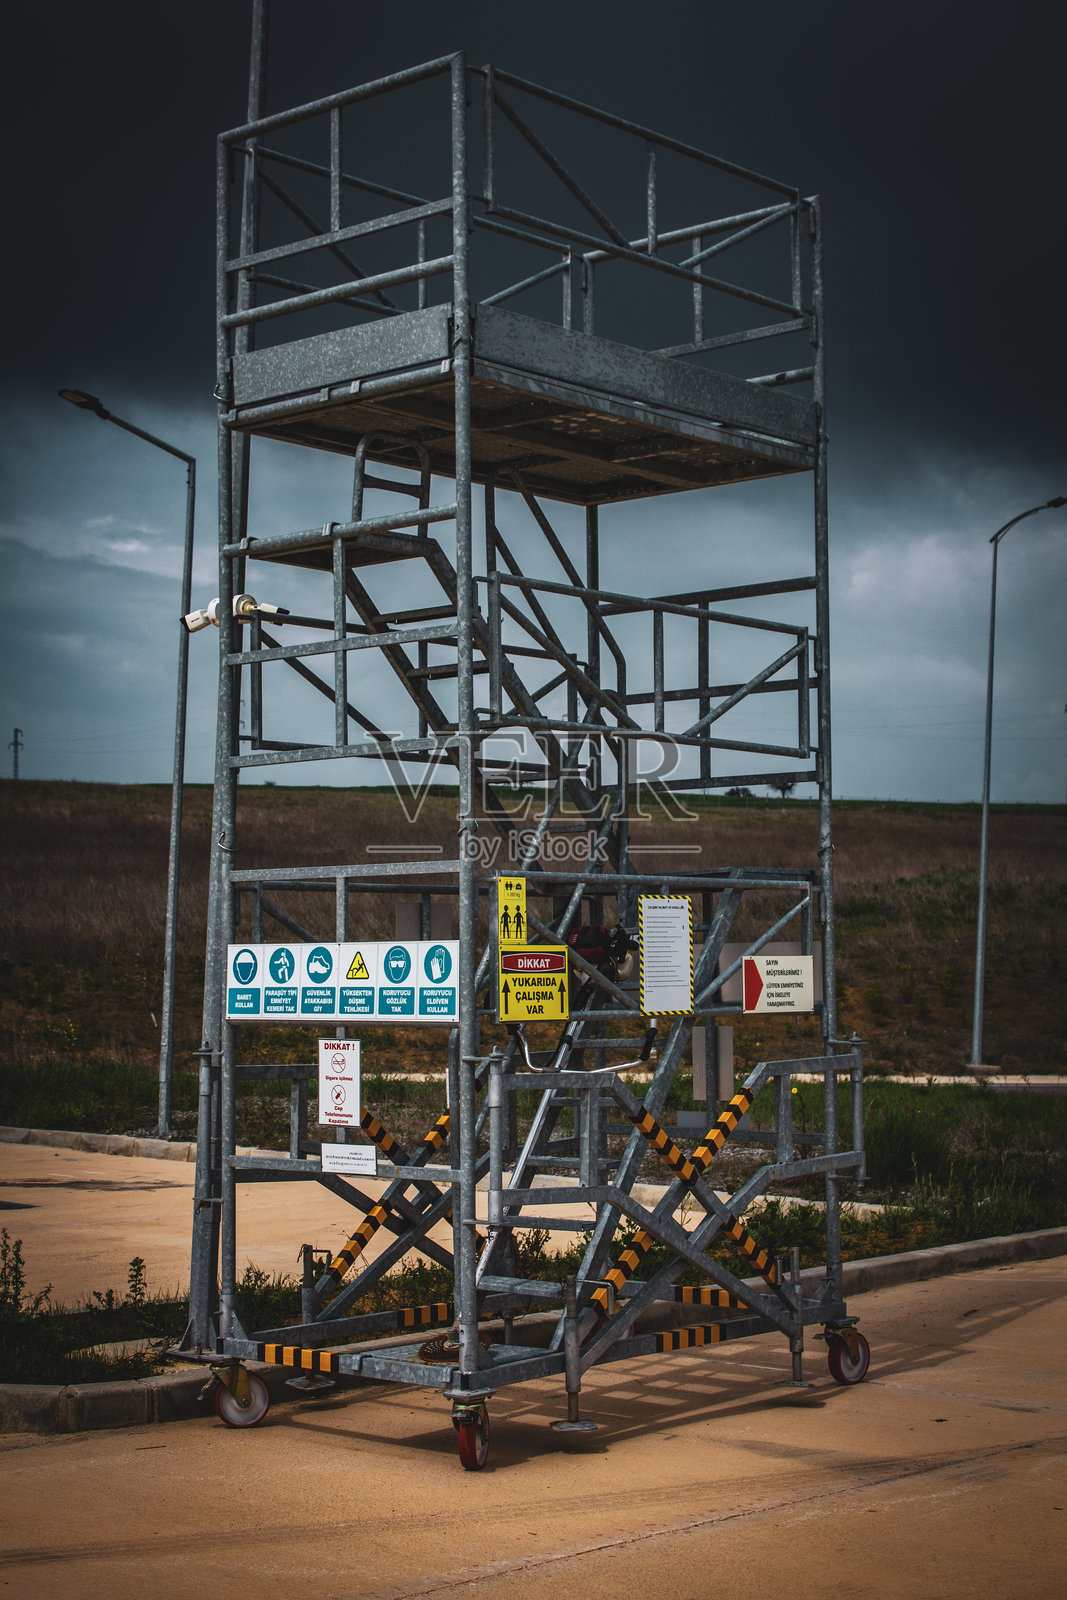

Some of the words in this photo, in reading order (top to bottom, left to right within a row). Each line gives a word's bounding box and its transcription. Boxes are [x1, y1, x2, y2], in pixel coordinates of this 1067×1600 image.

[518, 956, 550, 968] DİKKAT
[512, 977, 557, 987] YUKARIDA
[515, 991, 554, 1003] ÇALIŞMA
[526, 1005, 544, 1015] VAR
[324, 1041, 350, 1050] DİKKAT
